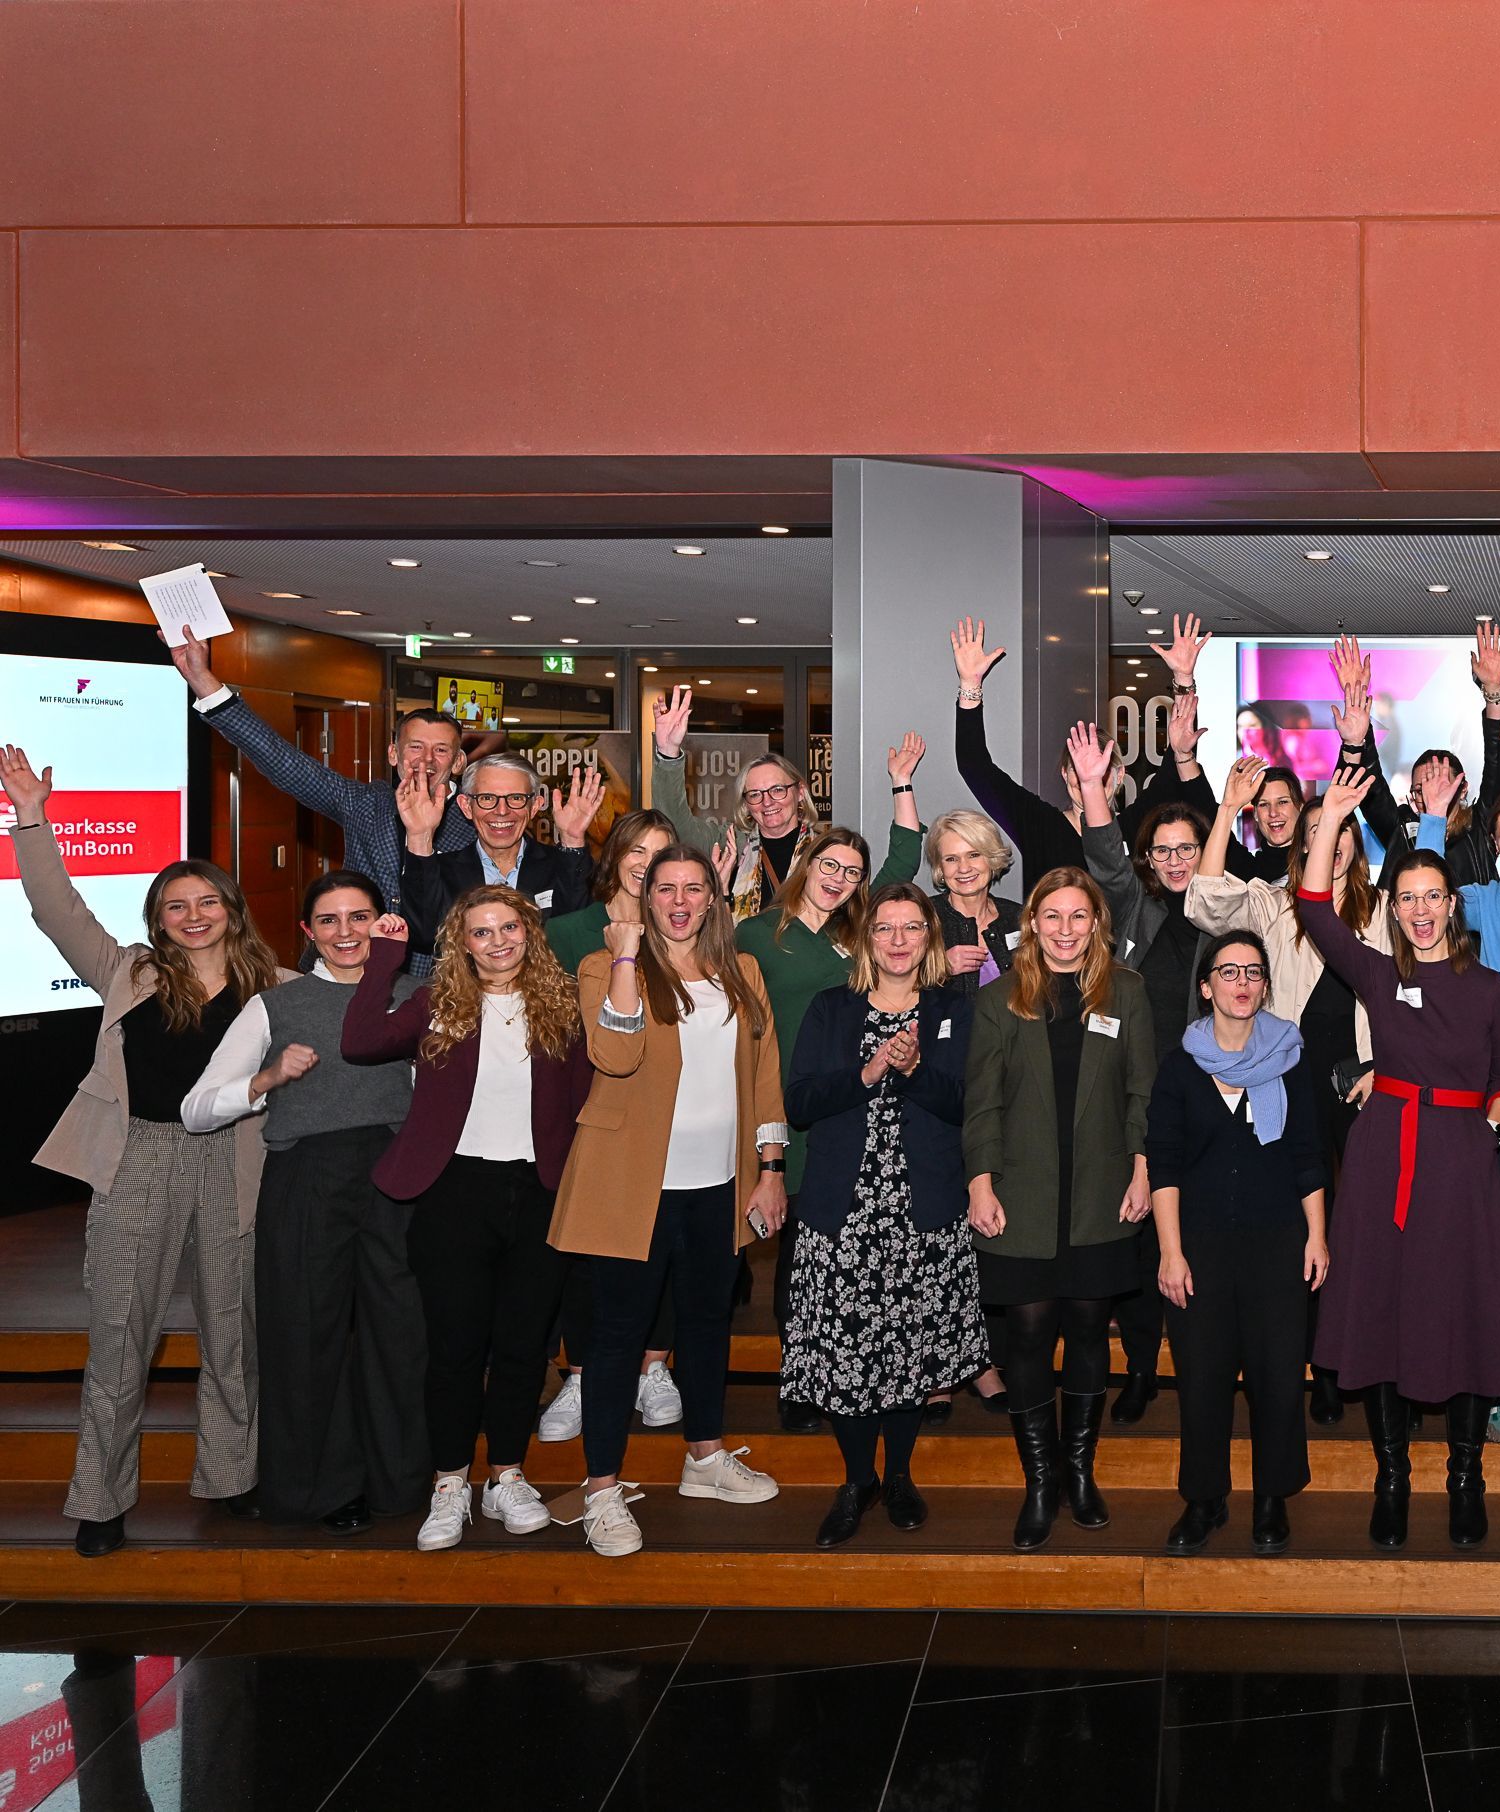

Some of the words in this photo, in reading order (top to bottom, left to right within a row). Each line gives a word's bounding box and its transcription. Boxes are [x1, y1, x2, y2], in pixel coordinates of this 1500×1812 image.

[39, 695, 52, 703] MIT
[53, 696, 81, 705] FRAUEN
[82, 697, 90, 705] IN
[91, 697, 124, 707] FÜHRUNG
[52, 818, 137, 836] parkasse
[57, 840, 134, 857] ölnBonn
[0, 1018, 40, 1034] ÖER
